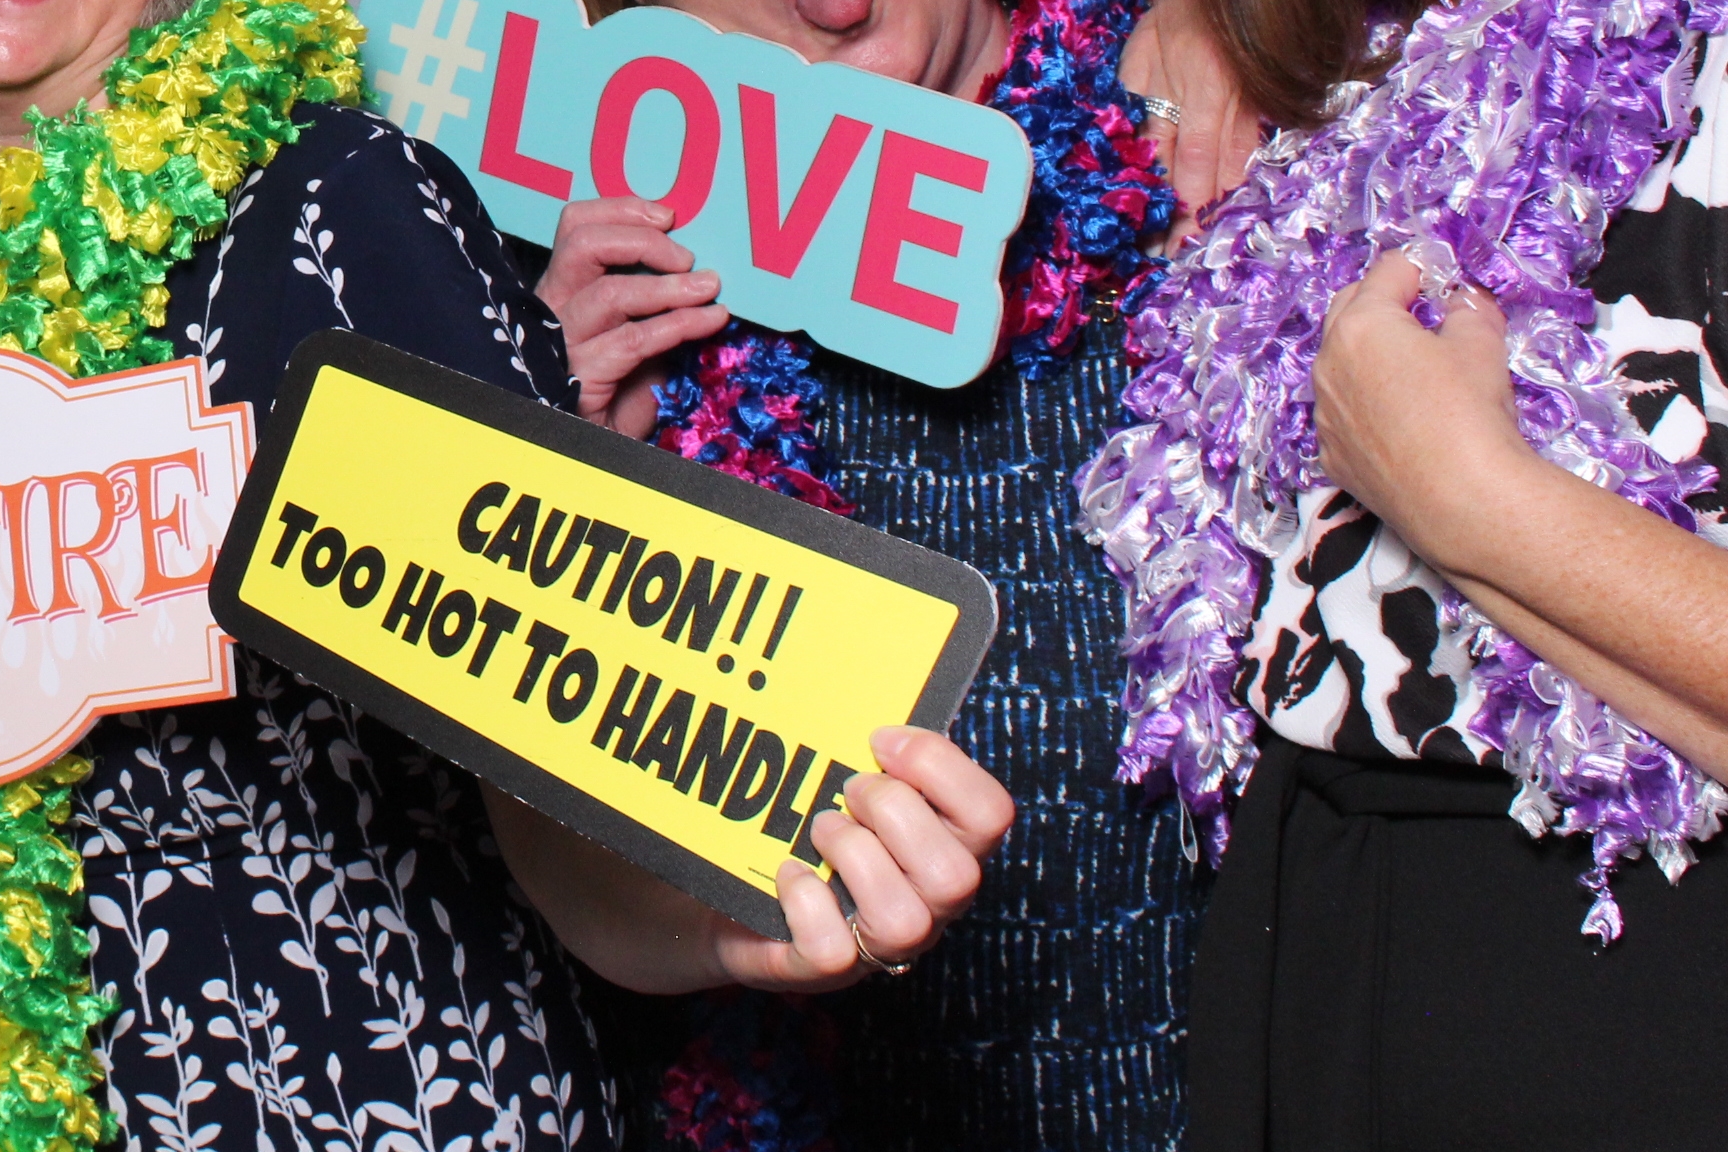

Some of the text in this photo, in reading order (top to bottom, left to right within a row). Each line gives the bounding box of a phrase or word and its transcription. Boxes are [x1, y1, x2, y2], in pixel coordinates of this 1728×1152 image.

[269, 502, 387, 609] TOO
[381, 561, 521, 679] HOT
[512, 619, 599, 724] TO
[457, 481, 804, 692] CAUTION!!
